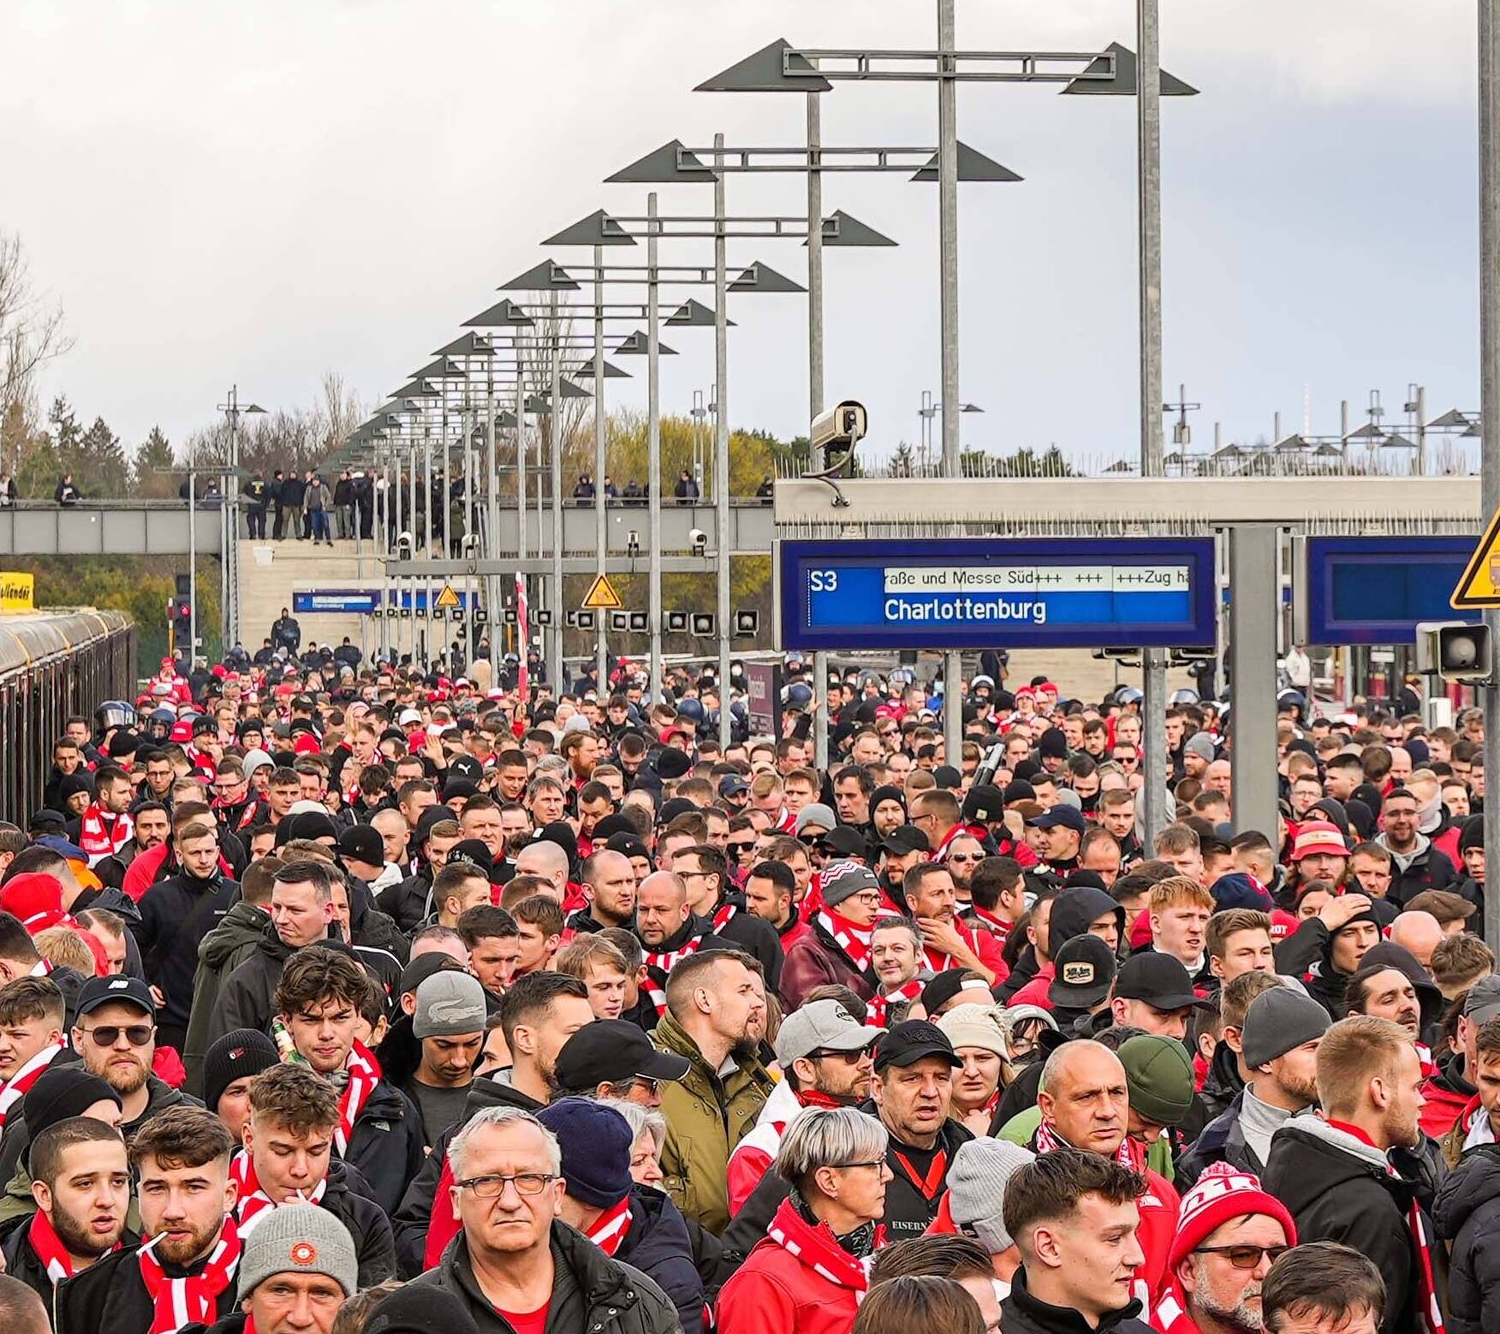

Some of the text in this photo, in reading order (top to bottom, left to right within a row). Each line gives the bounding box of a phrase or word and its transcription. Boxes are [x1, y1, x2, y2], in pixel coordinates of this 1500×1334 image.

[810, 570, 837, 592] S3
[922, 571, 947, 585] und
[952, 570, 1002, 585] Messe
[885, 598, 1046, 624] Charlottenburg
[891, 1220, 927, 1231] EISERN
